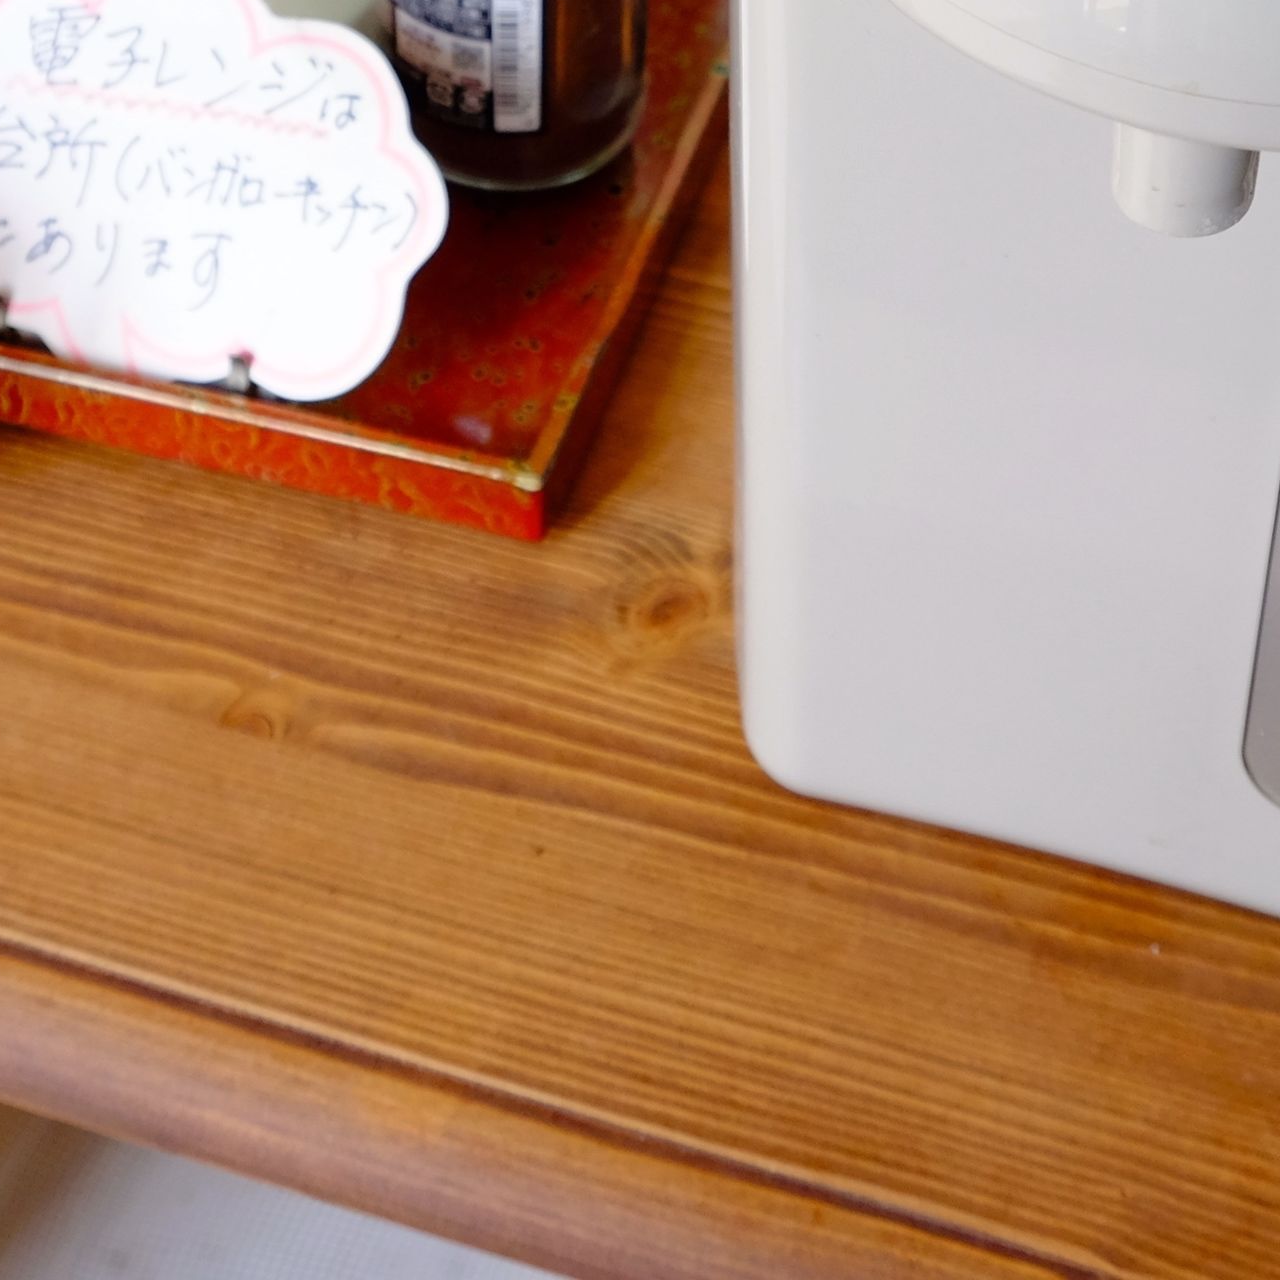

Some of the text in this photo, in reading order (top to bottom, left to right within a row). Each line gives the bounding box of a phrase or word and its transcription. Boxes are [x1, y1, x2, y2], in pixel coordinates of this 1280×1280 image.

[28, 5, 361, 132] 電子レンジは
